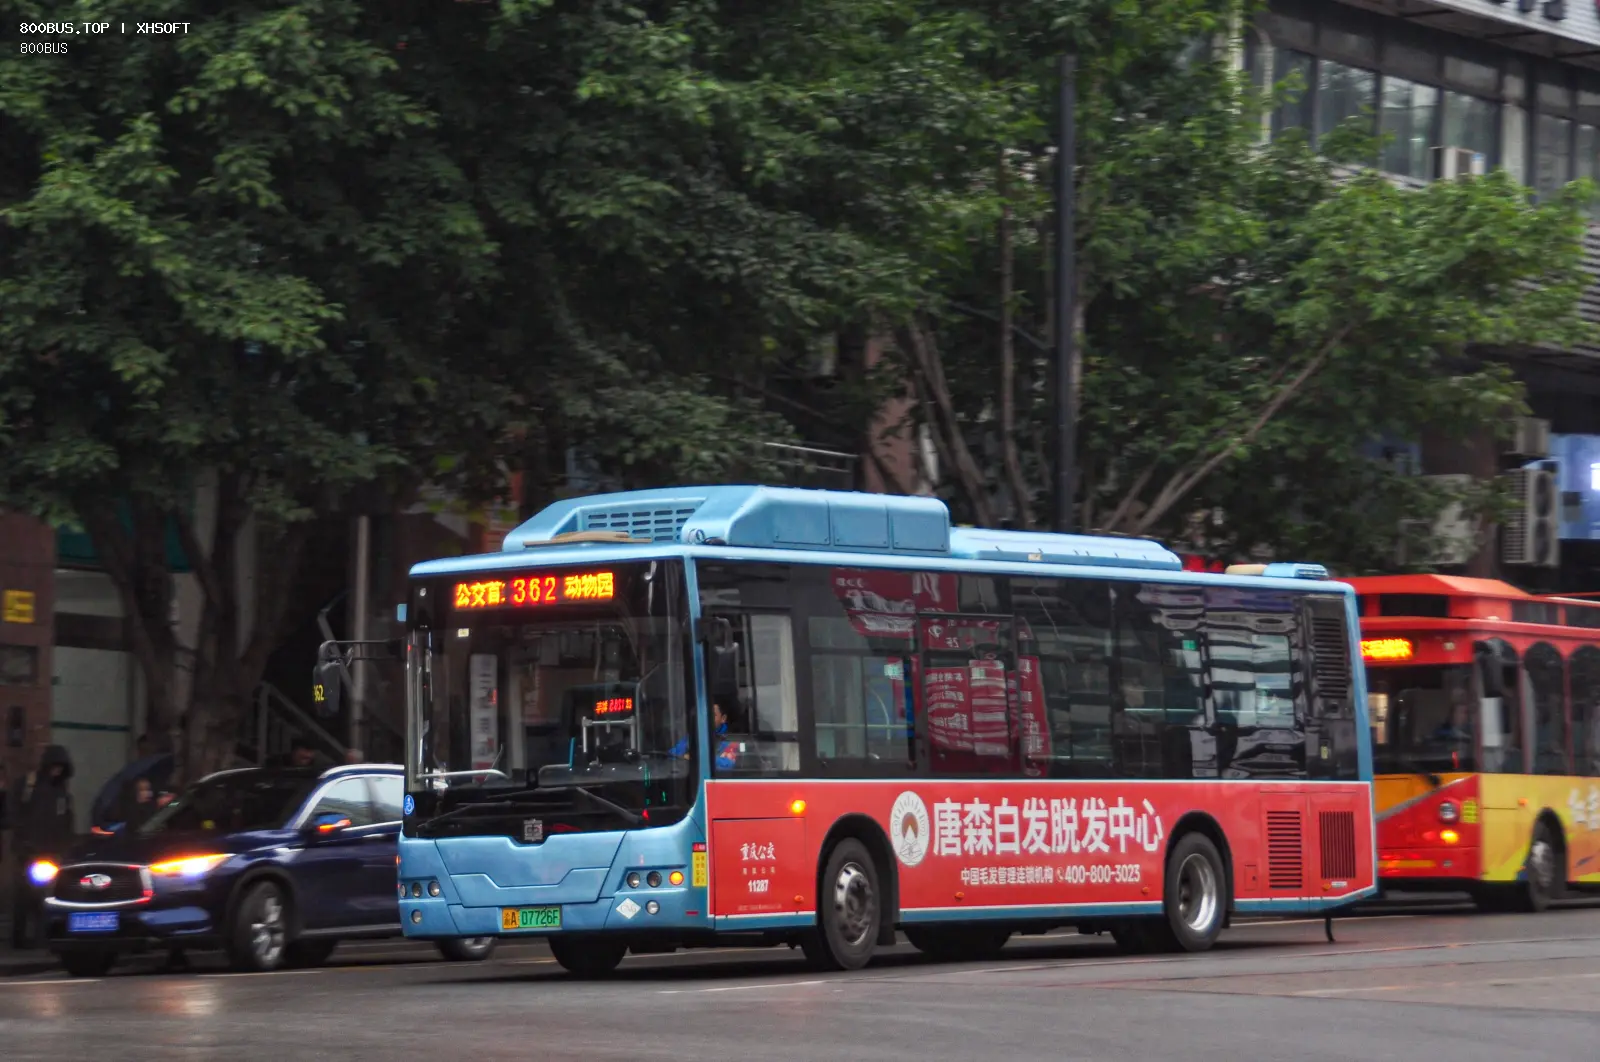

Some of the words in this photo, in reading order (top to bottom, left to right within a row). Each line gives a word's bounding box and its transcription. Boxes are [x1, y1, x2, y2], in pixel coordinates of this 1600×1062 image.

[455, 581, 506, 608] 公交首
[513, 576, 556, 603] 362
[564, 571, 614, 599] 动物园
[932, 796, 1165, 857] 唐森白发脱发中心
[740, 842, 776, 861] 重庆公交
[748, 879, 769, 893] 11287
[961, 866, 1054, 886] 中国毛发管理连锁机构
[1065, 863, 1141, 884] 400-800-3023
